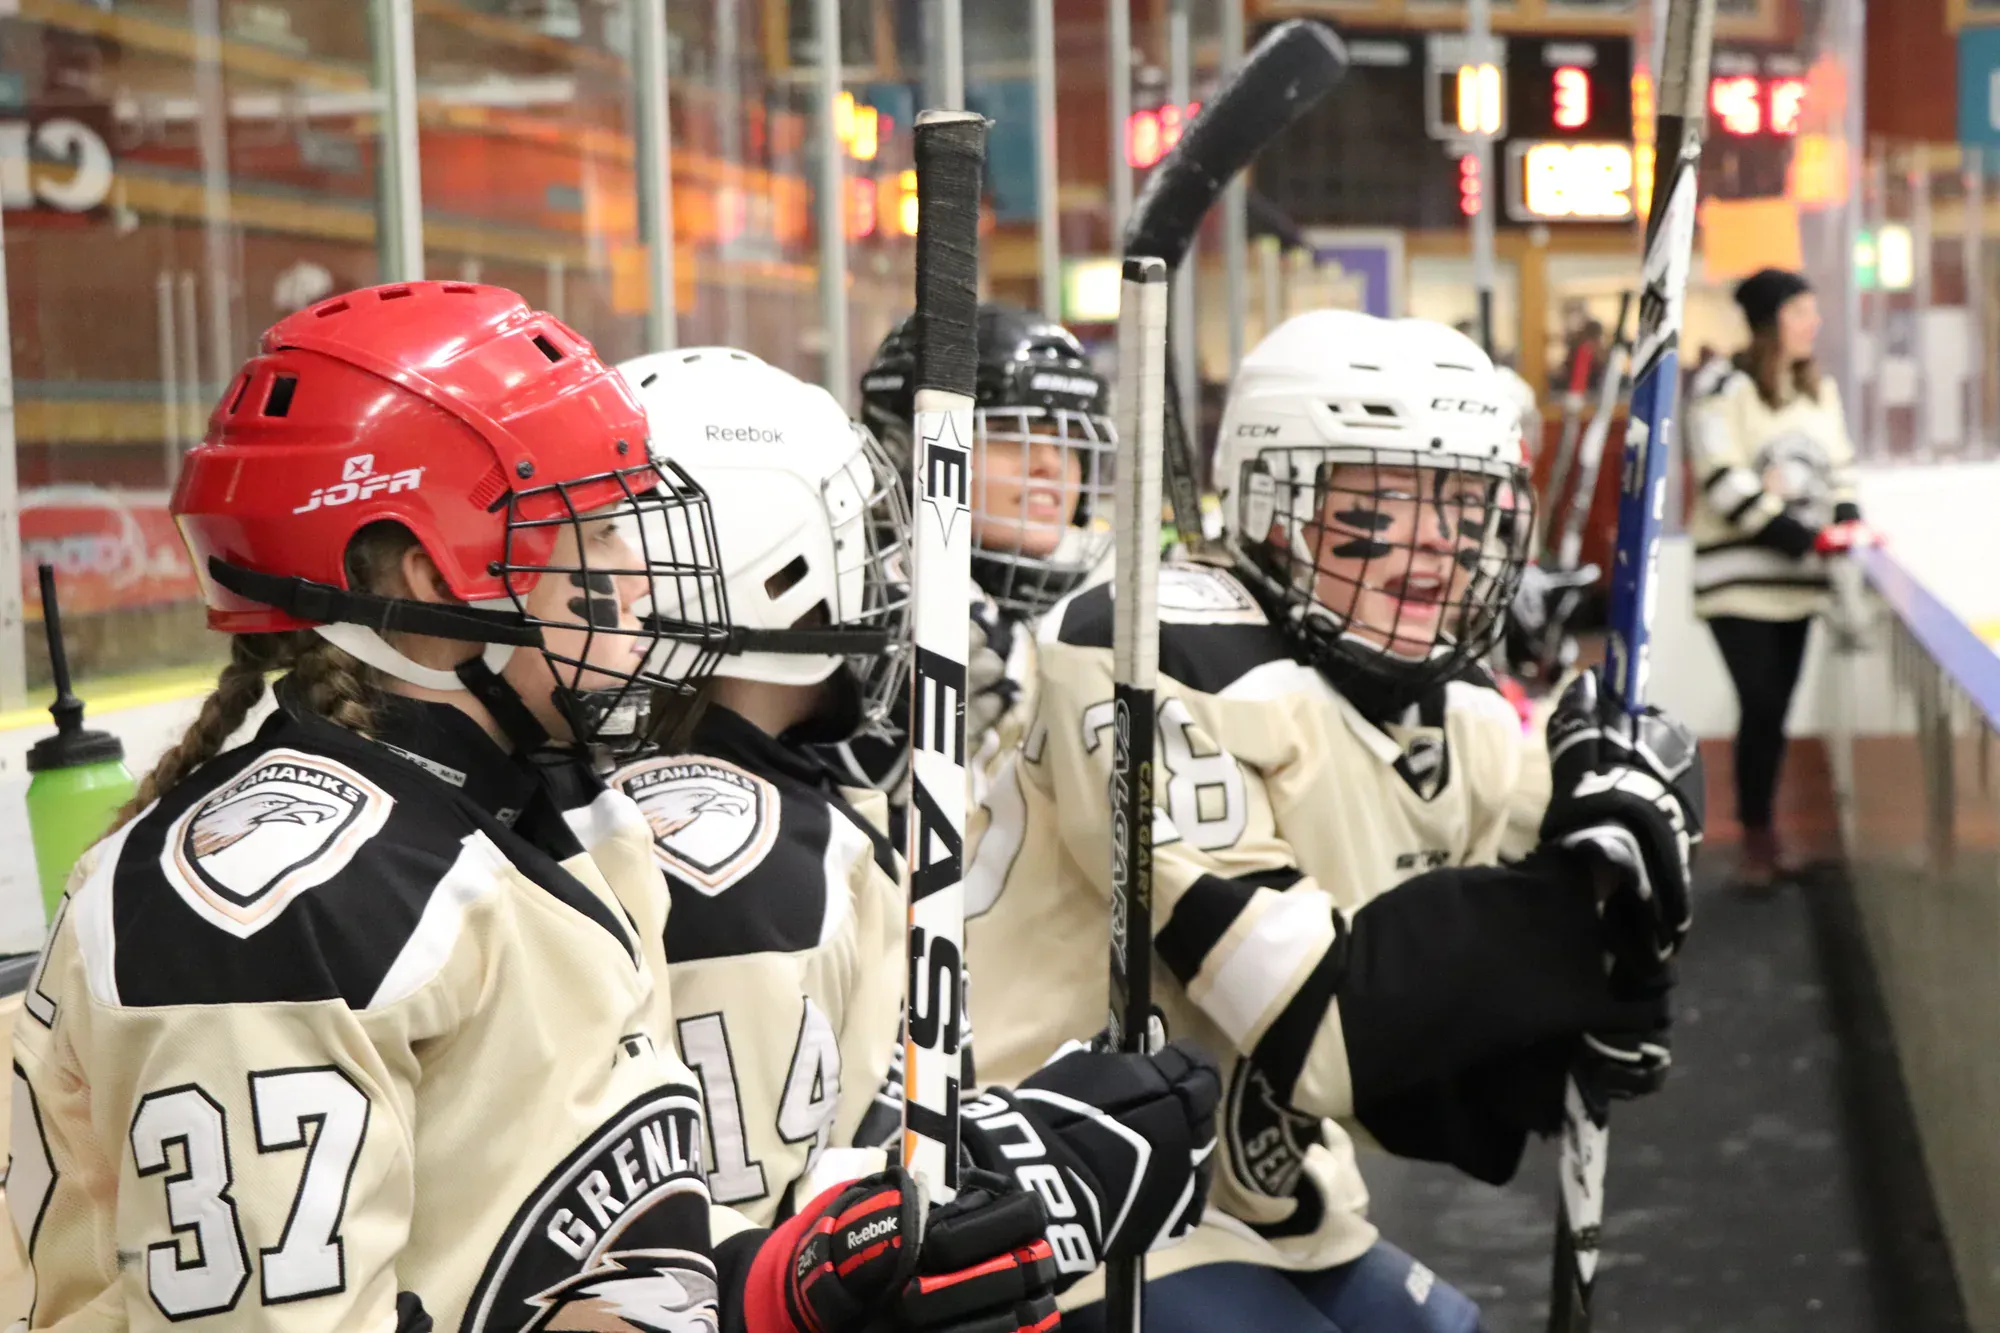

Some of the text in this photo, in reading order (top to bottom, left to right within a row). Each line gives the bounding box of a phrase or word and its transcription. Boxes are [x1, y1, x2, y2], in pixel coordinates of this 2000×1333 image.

[705, 424, 785, 445] Reebok
[1237, 424, 1281, 438] CCM
[1430, 397, 1499, 416] CCM
[292, 467, 424, 515] JOFA
[629, 764, 756, 792] SEAHAWKS
[1109, 697, 1131, 978] CALGARY
[1137, 761, 1154, 911] CALGARY
[905, 642, 968, 1193] EAST
[677, 994, 843, 1205] 14
[130, 1065, 370, 1323] 37
[546, 1114, 703, 1262] GRENLA
[846, 1215, 899, 1251] Reebok
